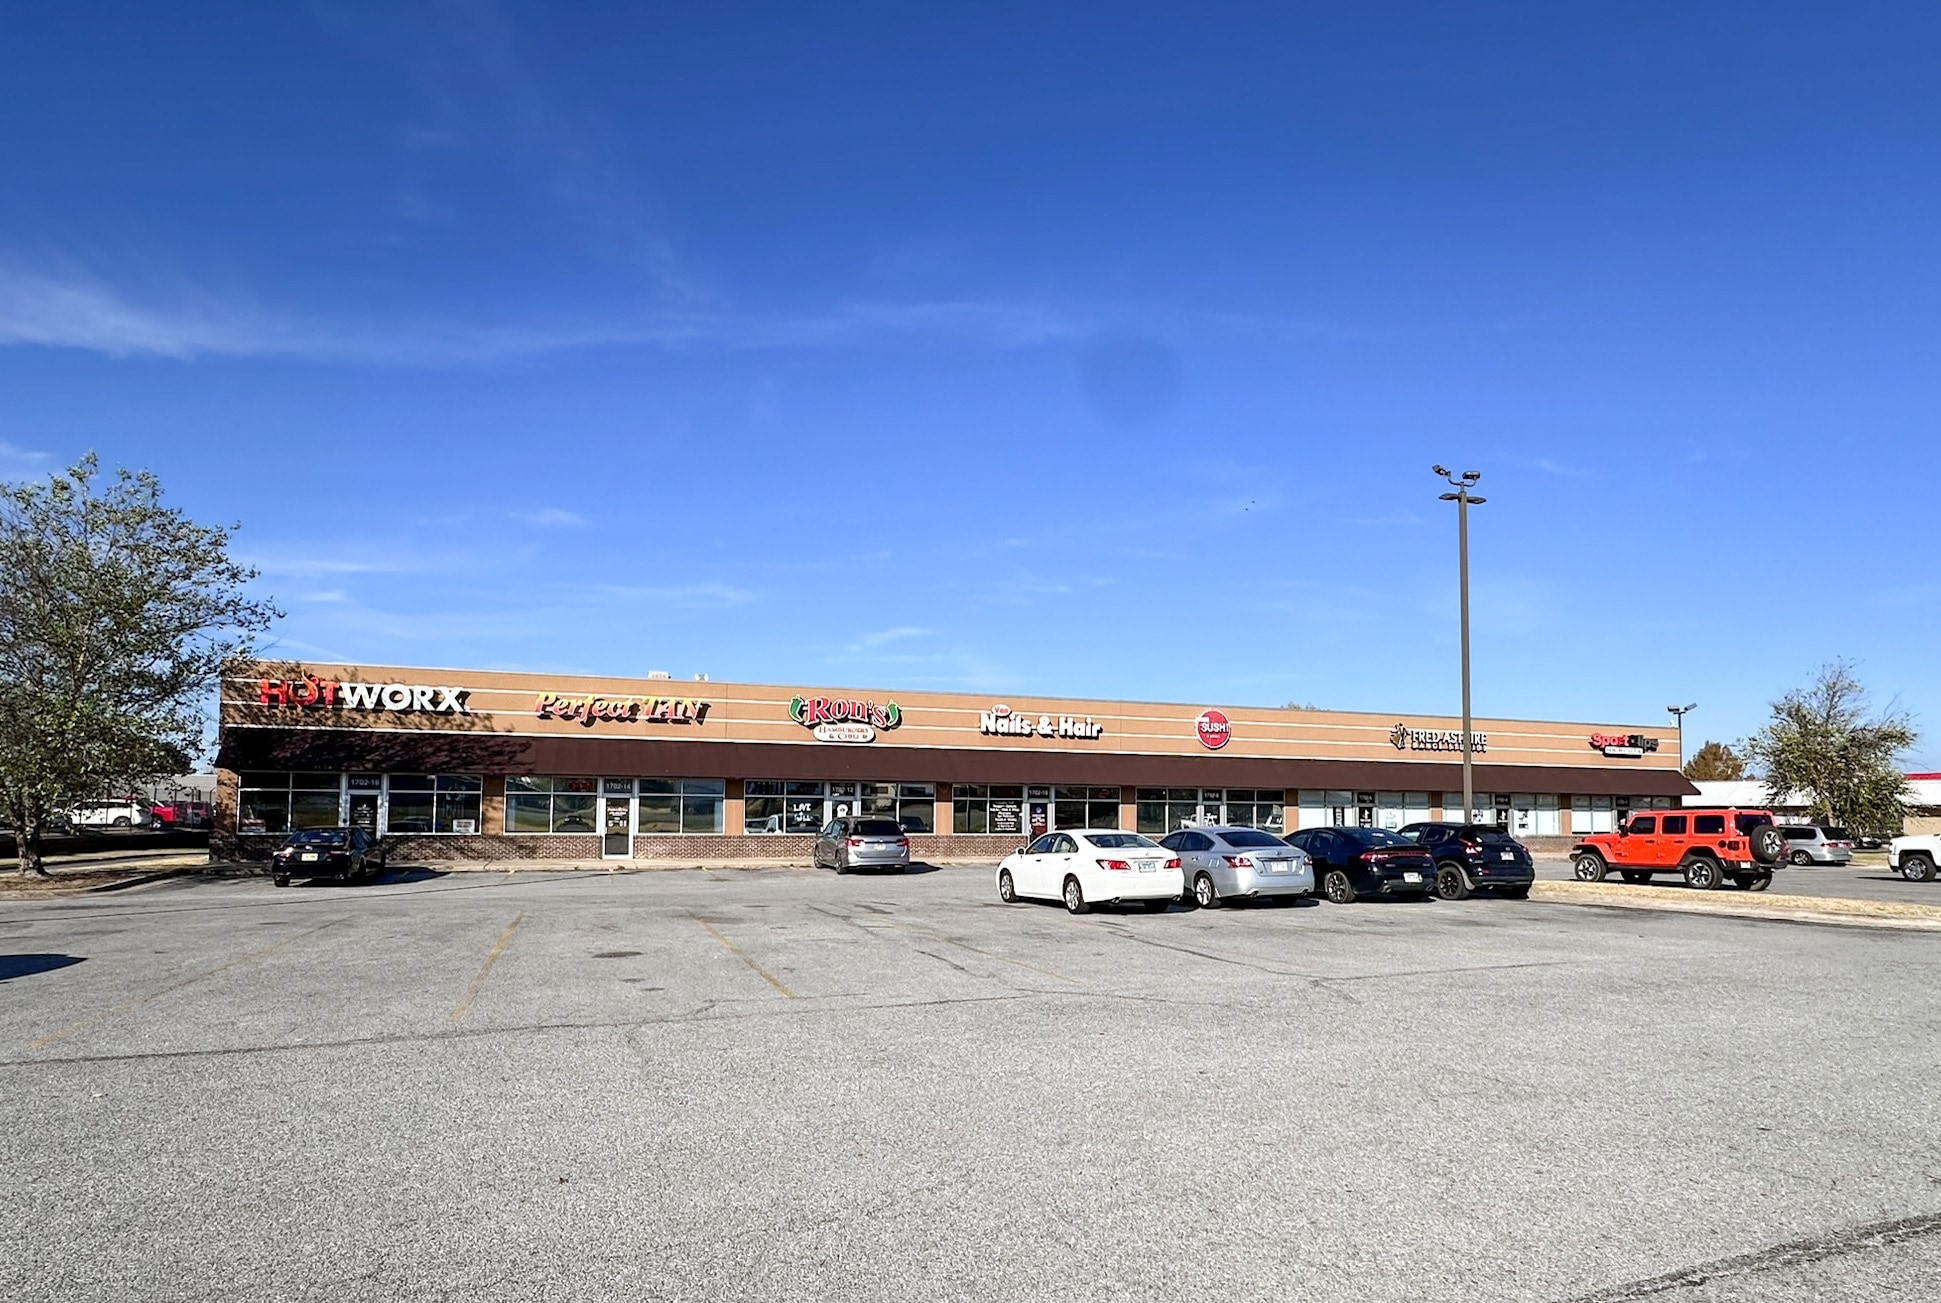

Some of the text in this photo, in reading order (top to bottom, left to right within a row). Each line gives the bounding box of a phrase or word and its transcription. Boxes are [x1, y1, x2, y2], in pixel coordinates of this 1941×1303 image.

[260, 670, 466, 712] HOTWORX
[534, 692, 702, 722] Perfect TAN
[804, 695, 887, 728] Ron's
[980, 712, 1102, 738] Nails & Hair
[1201, 722, 1229, 733] SUSHI
[1412, 731, 1488, 746] FRED ASTIRE
[1630, 735, 1659, 752] lips
[1448, 744, 1488, 752] STUIOS
[605, 782, 631, 790] 1702-14
